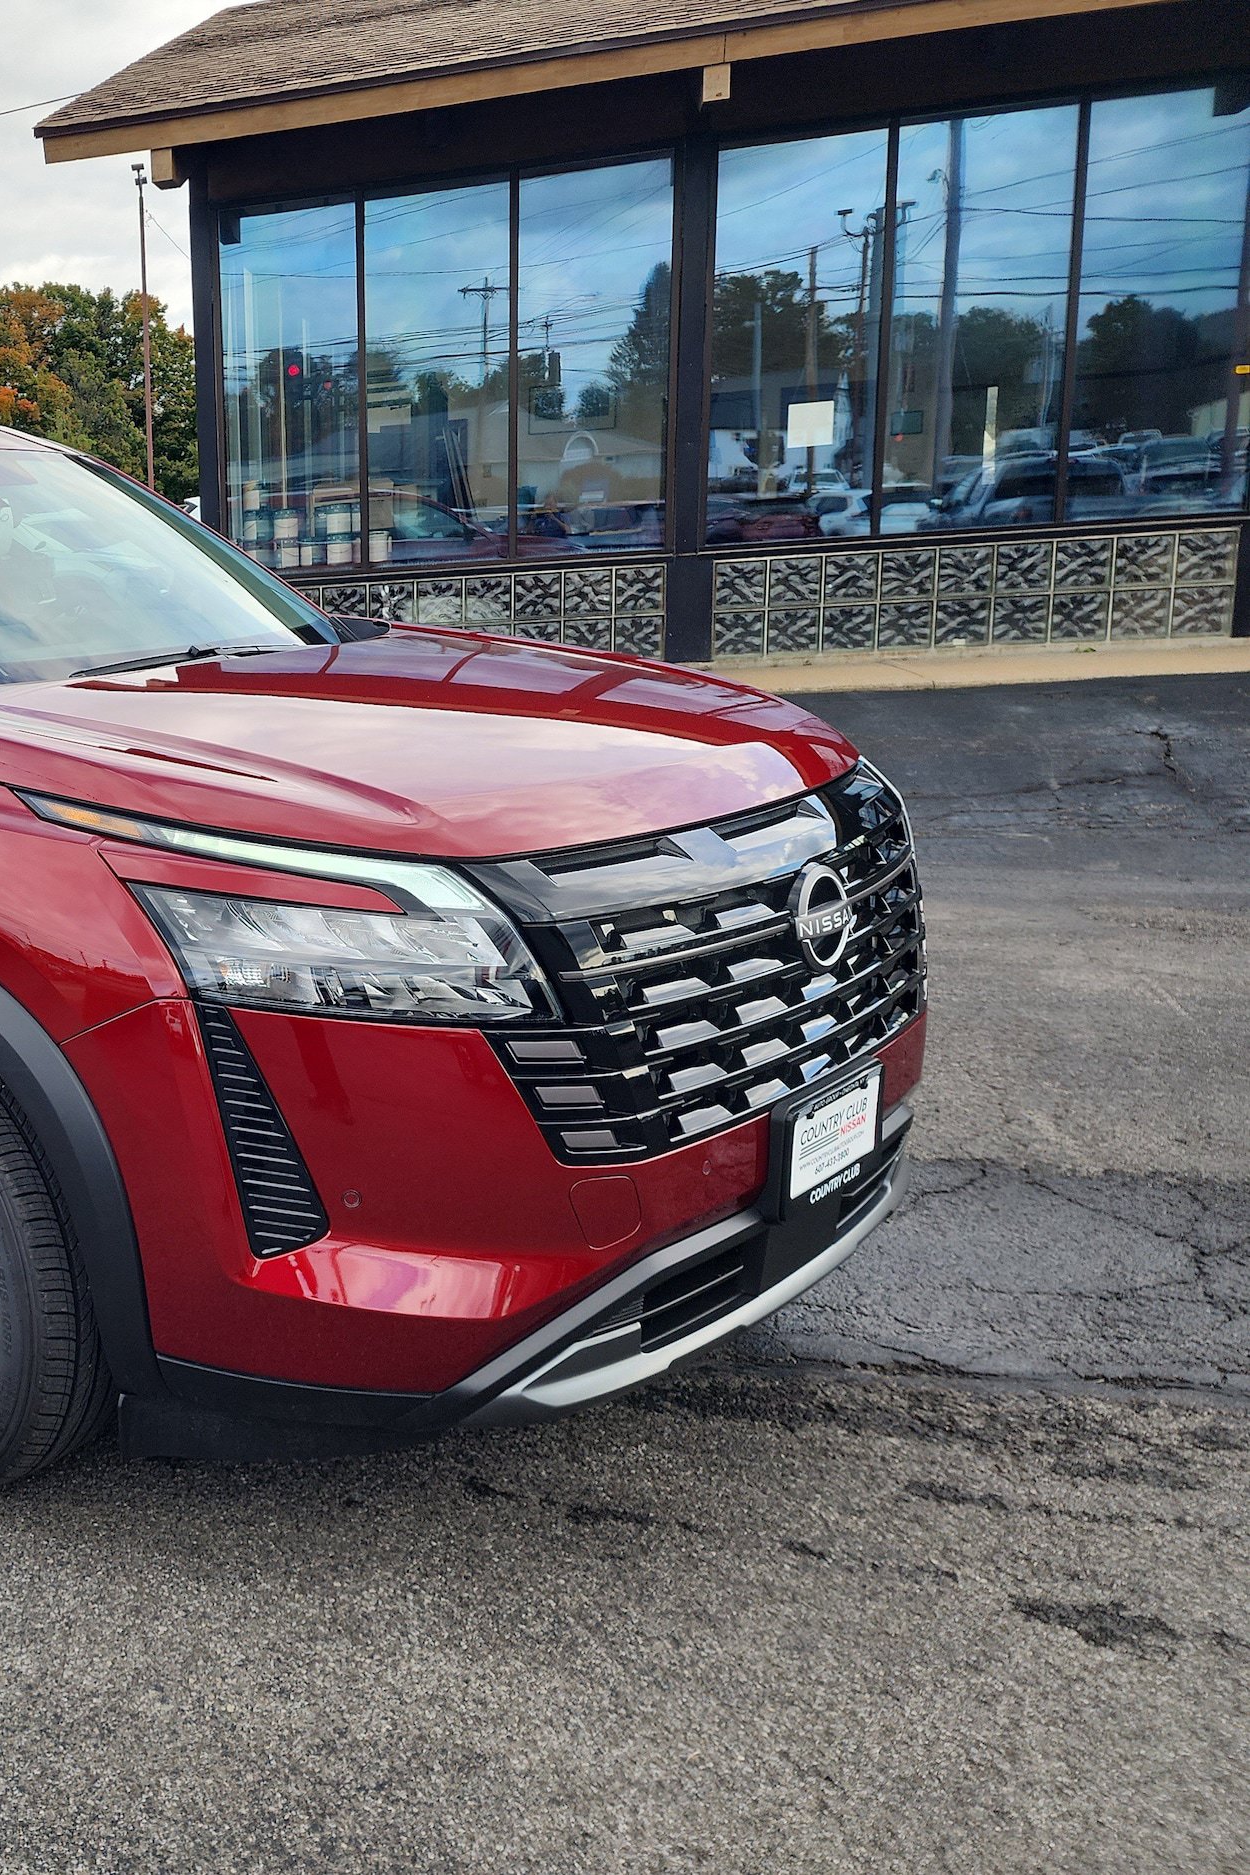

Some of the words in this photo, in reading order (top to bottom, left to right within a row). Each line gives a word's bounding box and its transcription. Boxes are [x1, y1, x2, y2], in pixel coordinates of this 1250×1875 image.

[800, 1109, 845, 1145] COUNTRY
[846, 1097, 868, 1120] CLUB
[840, 1113, 867, 1137] NISSAN
[809, 1173, 843, 1205] COUNTRY
[843, 1162, 861, 1184] CLUB
